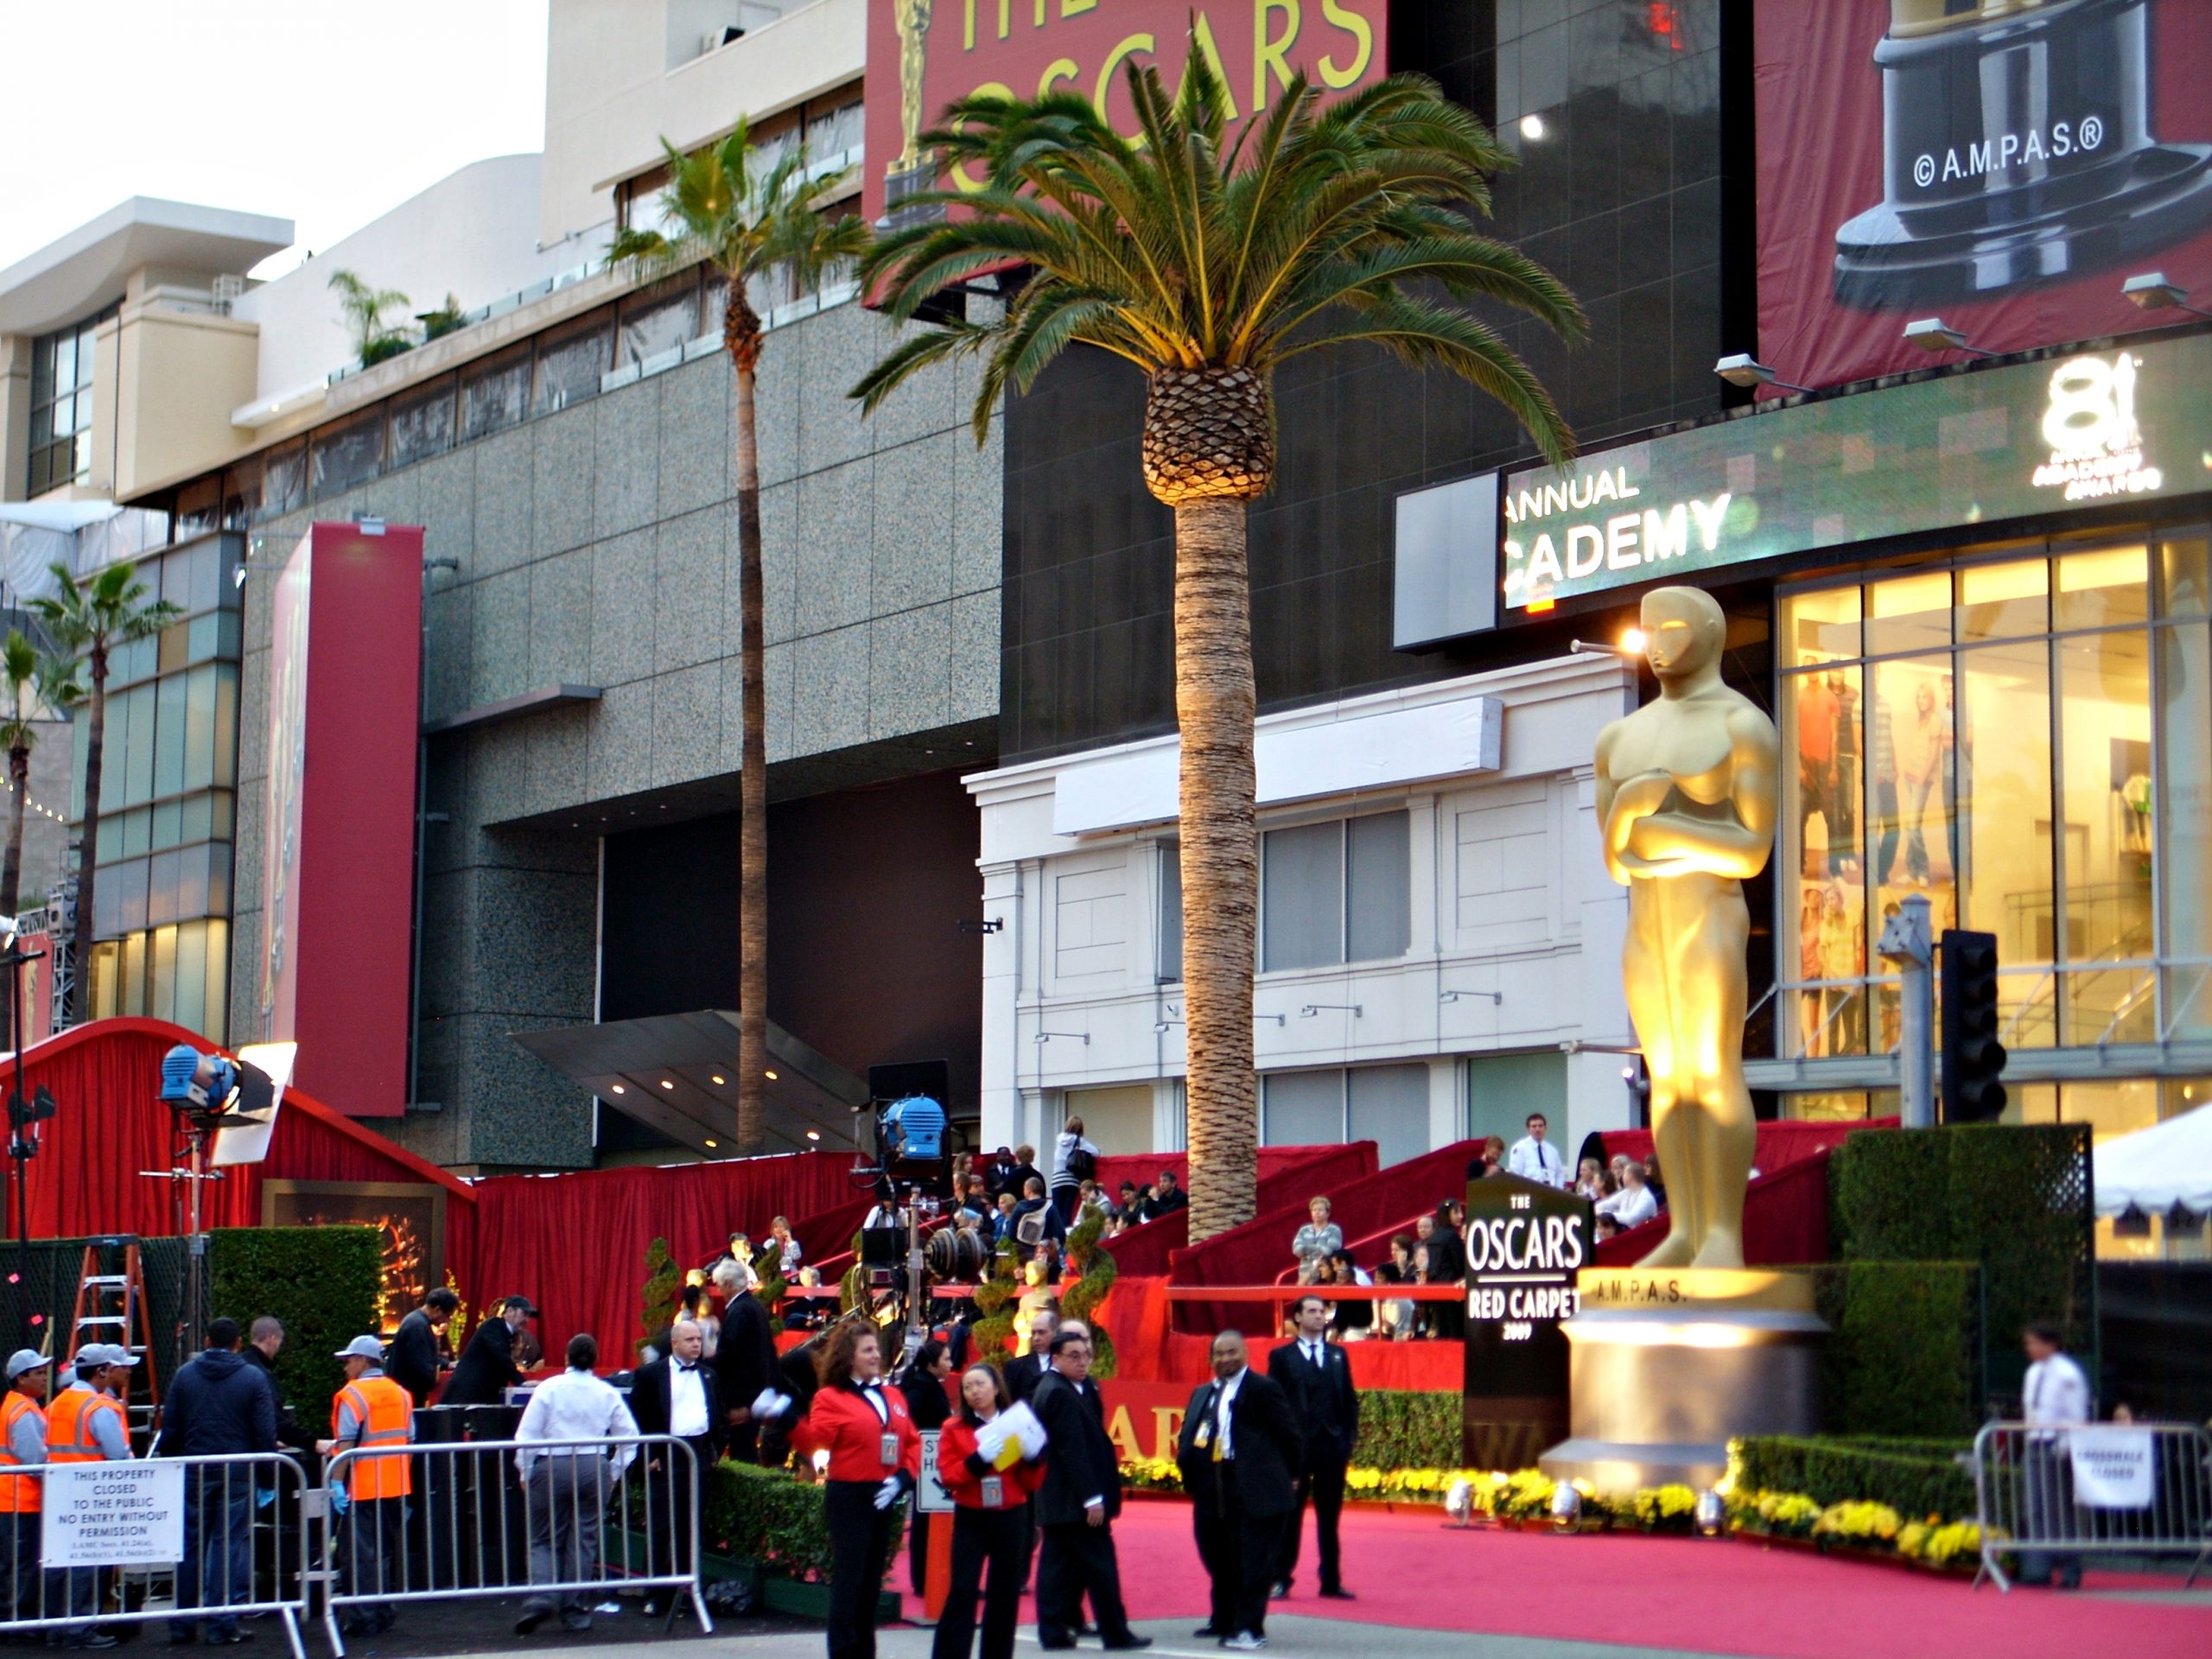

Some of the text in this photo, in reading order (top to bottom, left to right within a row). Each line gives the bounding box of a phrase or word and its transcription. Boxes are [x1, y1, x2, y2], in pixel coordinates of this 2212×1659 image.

[1510, 1194, 1530, 1210] THE
[1467, 1216, 1582, 1270] OSCARS
[1469, 1287, 1580, 1319] RED CARPET
[73, 1469, 156, 1481] THIS PROPERTY
[92, 1484, 137, 1495] CLOSED
[73, 1497, 155, 1510] TO THE PUBLIC
[58, 1510, 168, 1524] NO ENTRY WITHOUT
[79, 1526, 148, 1537] PERMISSION
